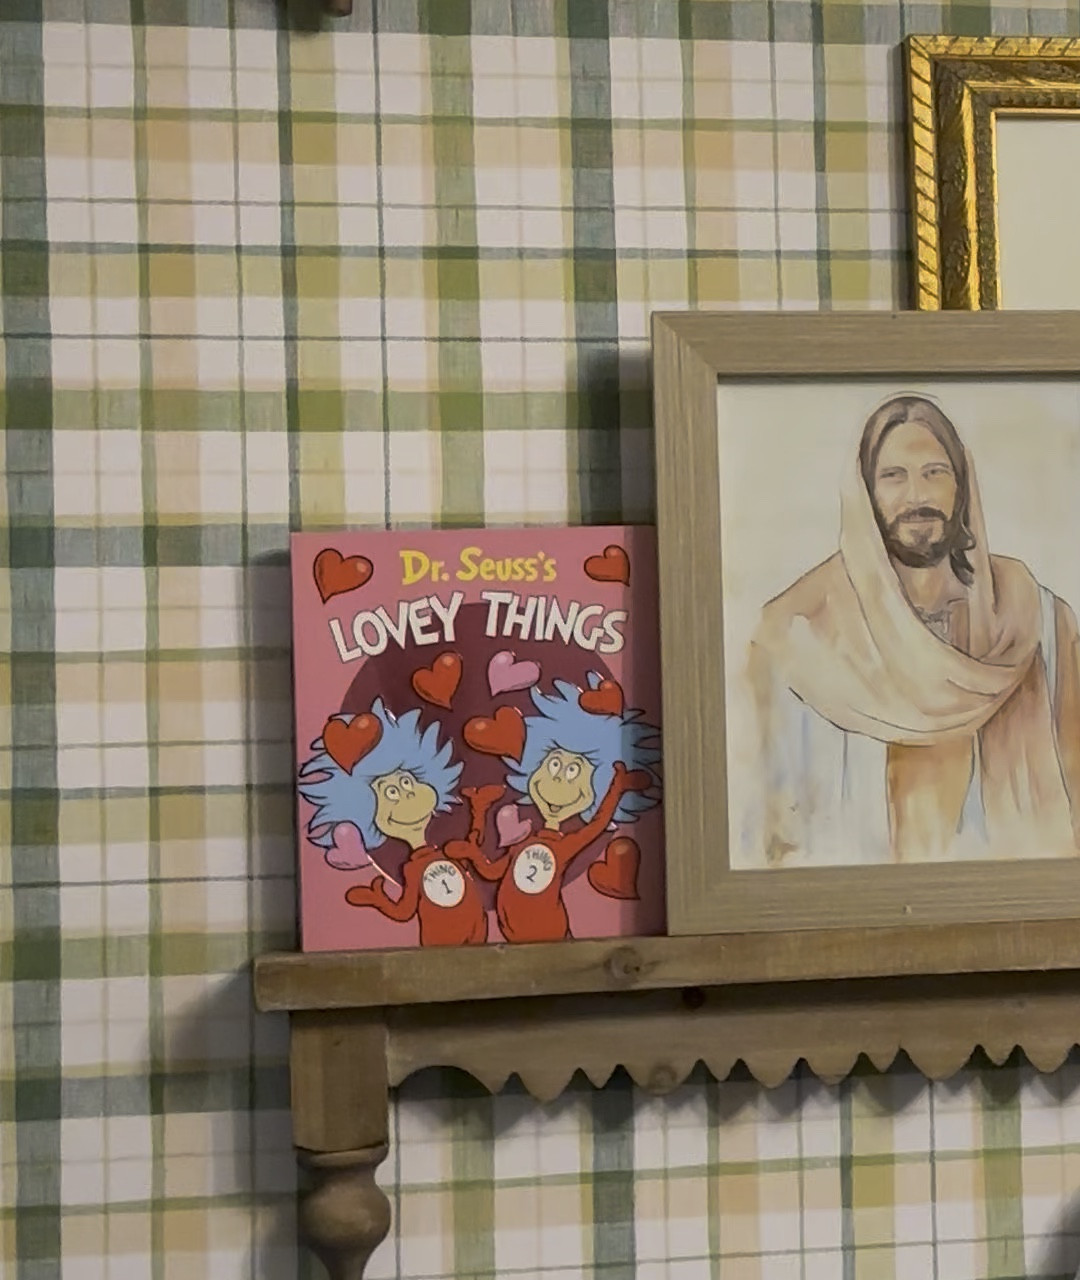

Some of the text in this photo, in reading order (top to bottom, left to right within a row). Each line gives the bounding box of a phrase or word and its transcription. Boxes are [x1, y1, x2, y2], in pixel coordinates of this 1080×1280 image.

[398, 546, 557, 585] Dr. Seuss's
[328, 590, 630, 664] LOVEY THINGS
[525, 849, 554, 871] THING
[424, 864, 457, 882] THING
[525, 864, 538, 883] 2
[441, 878, 453, 895] 1
